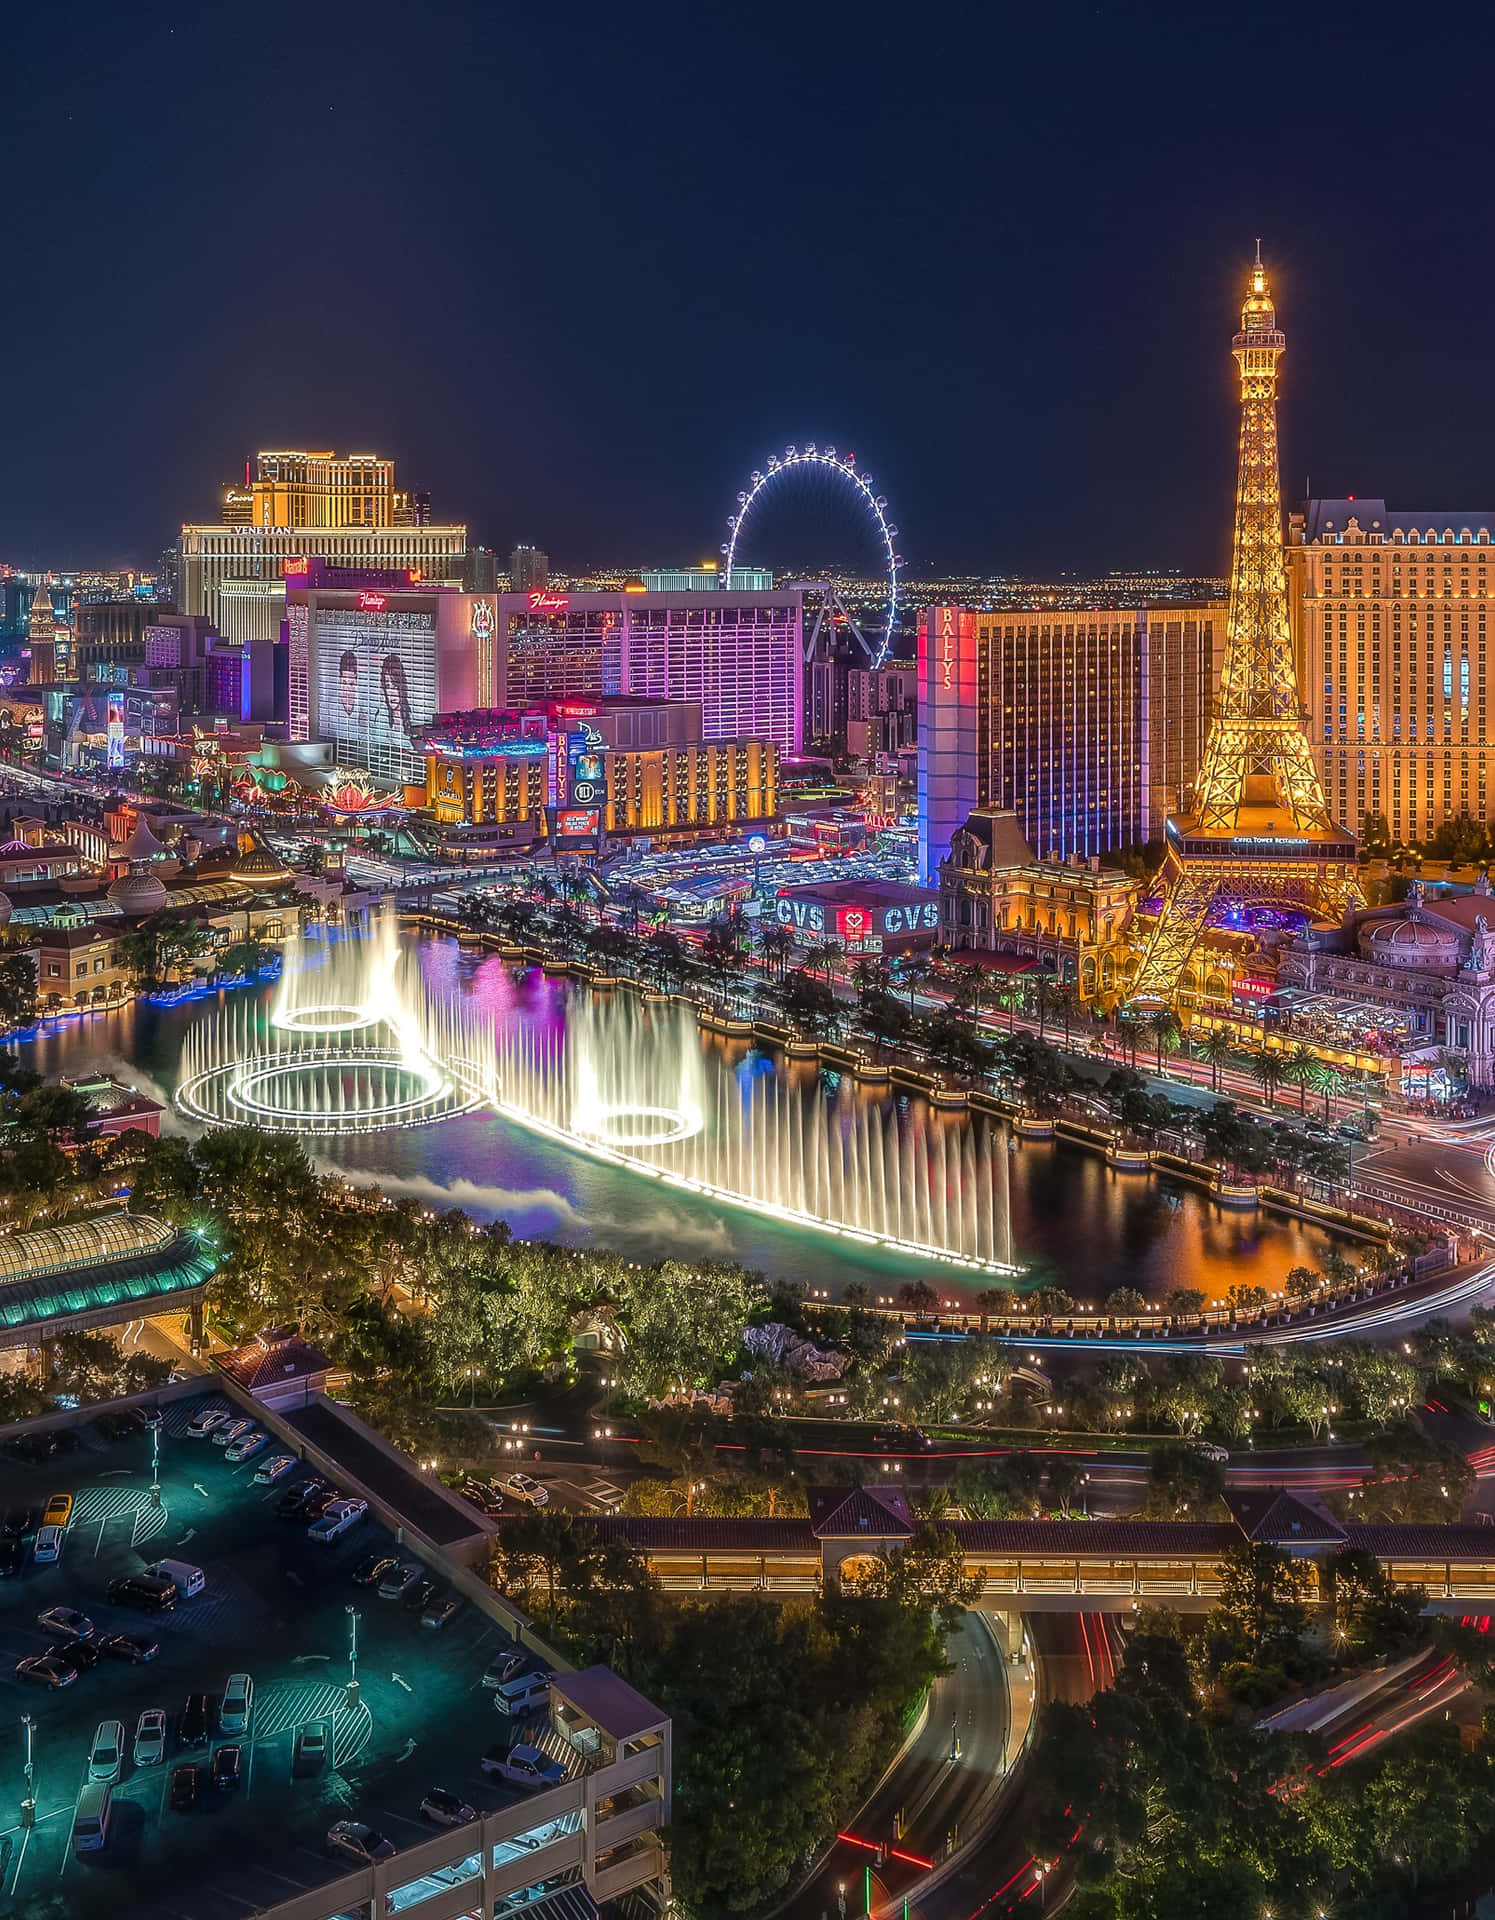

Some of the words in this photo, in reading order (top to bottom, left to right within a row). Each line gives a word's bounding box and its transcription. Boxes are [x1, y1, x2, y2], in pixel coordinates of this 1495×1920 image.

[234, 526, 292, 535] VENETIAN
[776, 899, 824, 931] CVS
[884, 903, 939, 933] CVS
[1232, 979, 1250, 992] BEER
[1251, 984, 1271, 995] PARK
